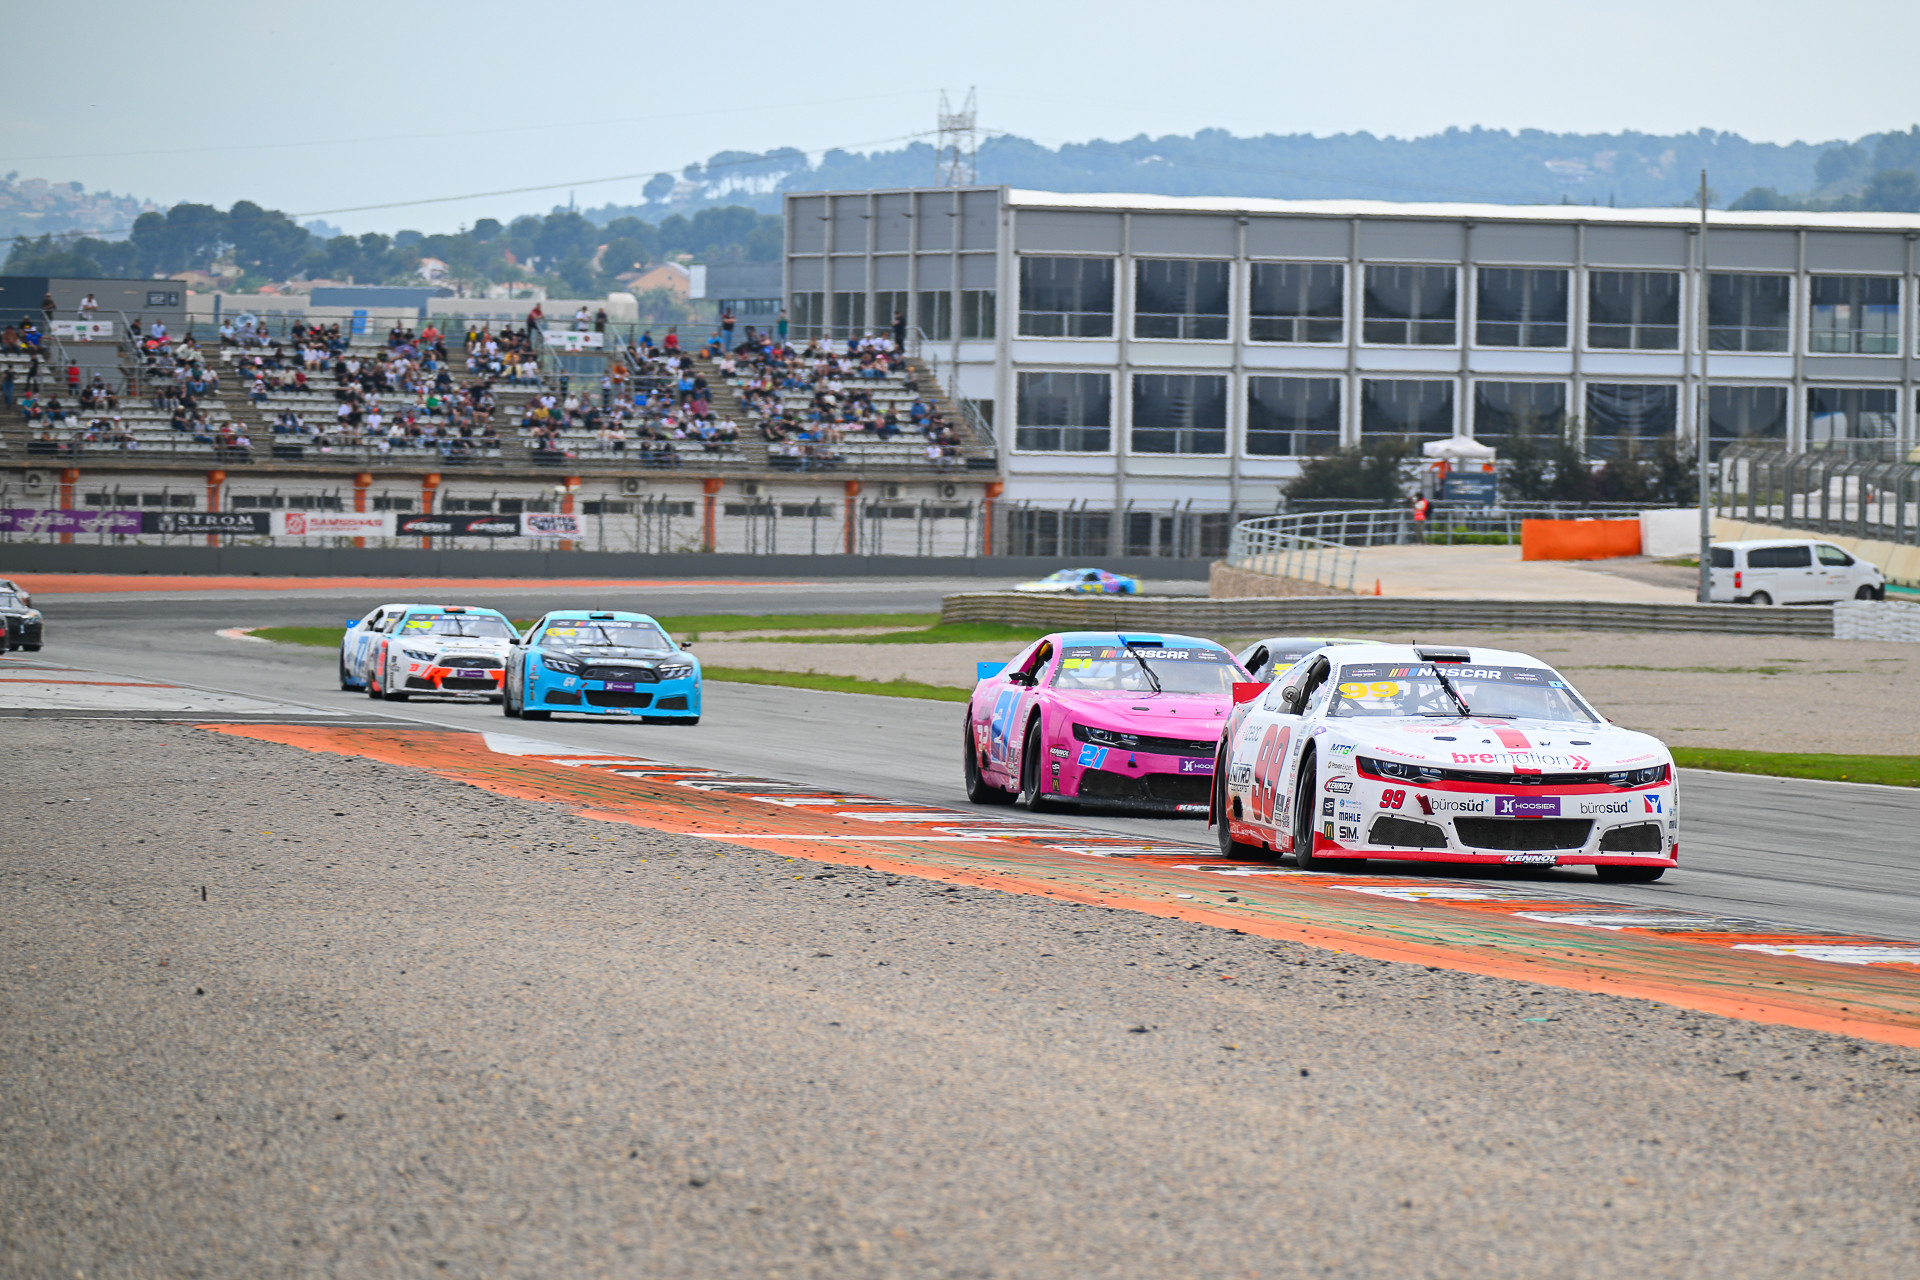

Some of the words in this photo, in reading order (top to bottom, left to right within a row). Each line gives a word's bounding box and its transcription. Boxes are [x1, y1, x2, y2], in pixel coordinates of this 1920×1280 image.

[177, 515, 254, 525] STROM
[545, 627, 577, 637] 64
[1122, 650, 1189, 660] NASCAR
[1062, 658, 1093, 669] 21
[1417, 667, 1502, 679] NASCAR
[563, 677, 577, 687] 64
[1338, 681, 1400, 699] 99
[1077, 743, 1110, 770] 21
[1451, 752, 1570, 766] bremotion
[1229, 765, 1252, 784] NITRO
[1251, 723, 1291, 825] 99
[1379, 789, 1406, 809] 99
[1431, 798, 1484, 812] bürosüd
[1580, 801, 1629, 814] bürosüd
[1338, 811, 1361, 822] MAHLE
